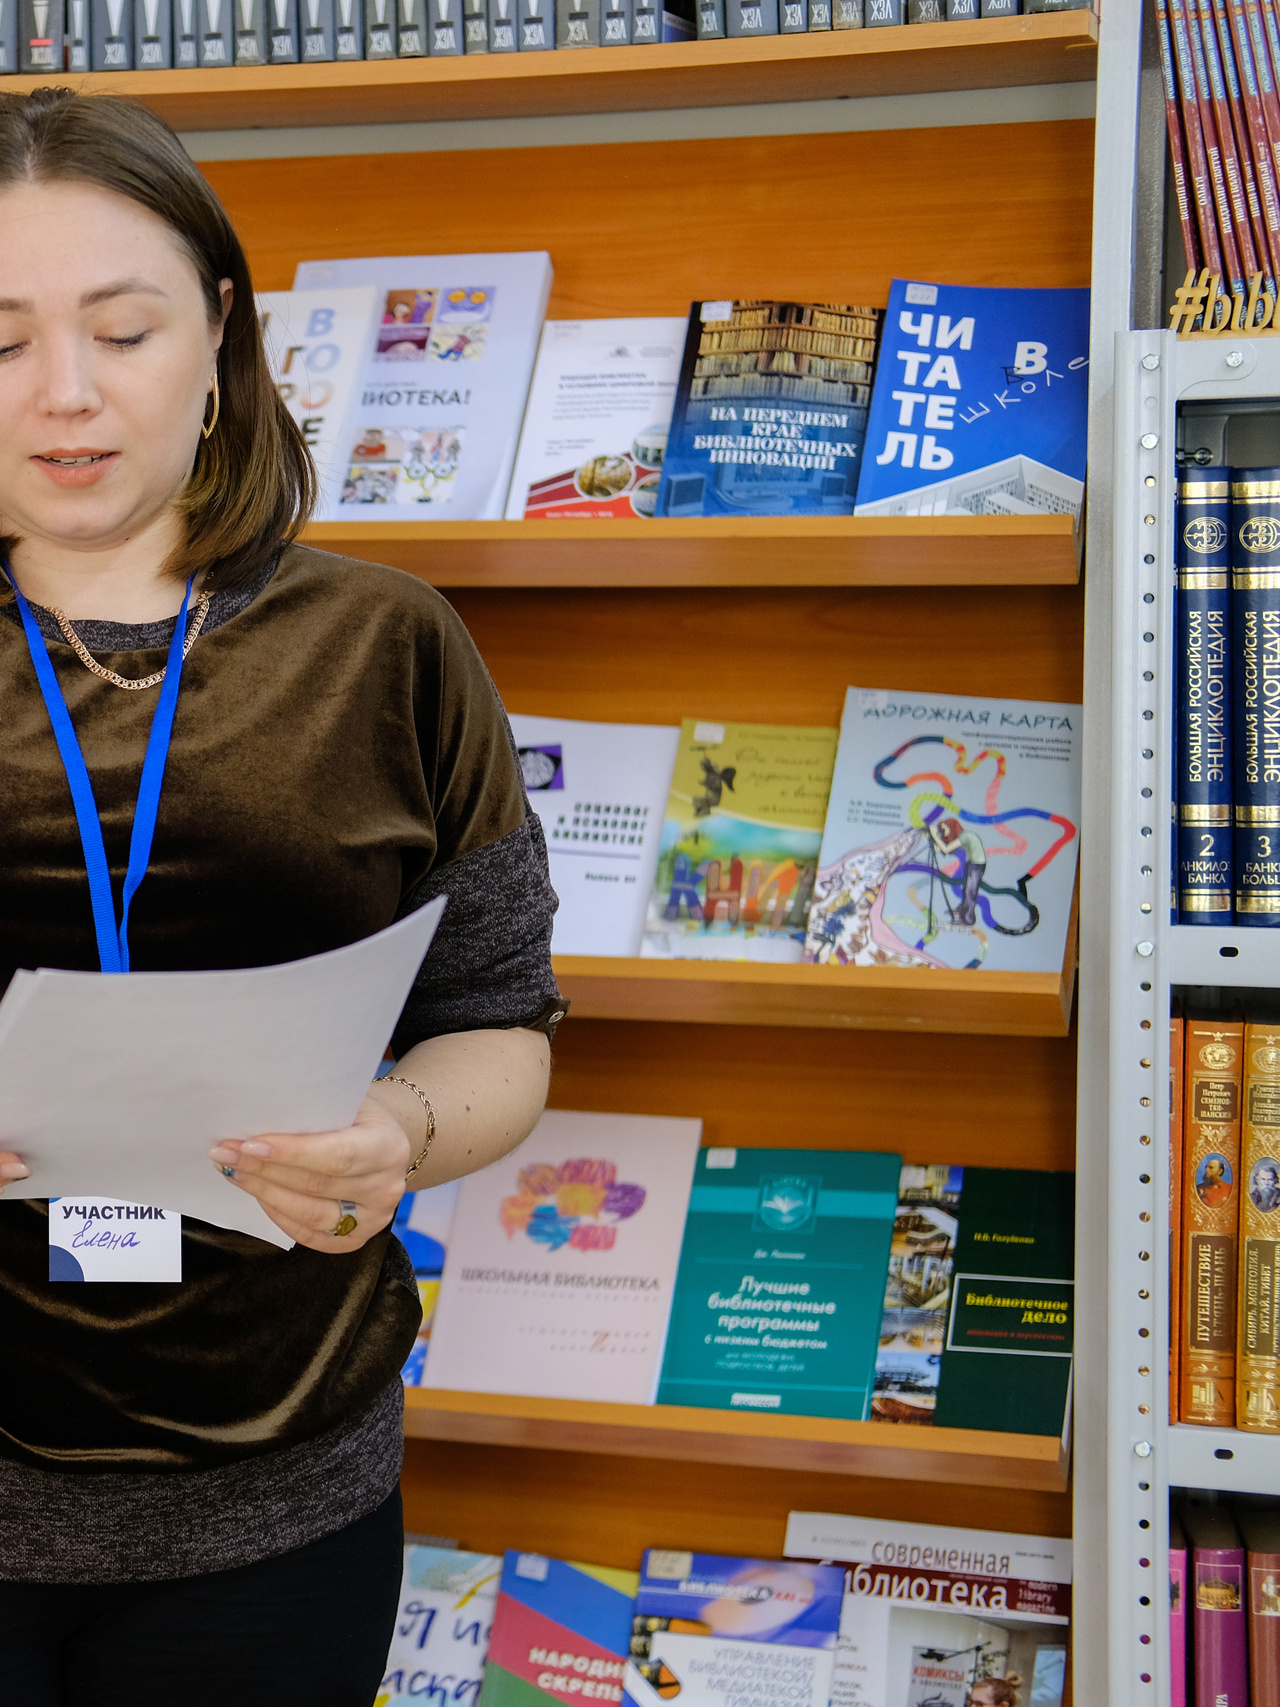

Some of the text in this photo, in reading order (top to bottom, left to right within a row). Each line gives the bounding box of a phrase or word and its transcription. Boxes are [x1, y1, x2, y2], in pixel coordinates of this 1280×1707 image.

[700, 10, 718, 31] ЖЗЛ
[740, 8, 763, 29] ЖЗЛ
[784, 6, 803, 27] ЖЗЛ
[811, 4, 830, 24] ЖЗЛ
[871, 0, 893, 21] ЖЗЛ
[523, 25, 545, 46] ЖЗЛ
[568, 21, 588, 42] ЖЗЛ
[605, 19, 627, 40] ЖЗЛ
[635, 15, 656, 37] ЖЗЛ
[434, 28, 456, 49] ЖЗЛ
[1225, 158, 1240, 193] КАЛИТА
[1259, 162, 1275, 205] ГРОЗНЫЙ
[1174, 162, 1189, 220] ВЕЩИЙ ОЛЕГ
[1195, 175, 1208, 207] ОЛЬГА
[1208, 147, 1232, 233] ВЛАДИМИР СВЯТОЙ
[1233, 199, 1245, 222] ИВАН
[1248, 194, 1261, 217] ИВАН
[710, 406, 850, 429] НА ПЕРЕДНЕМ
[751, 422, 803, 439] КРАЕ
[693, 435, 858, 459] БИБЛИОТЕЧНЫХ
[709, 450, 837, 471] ИННОВАЦИЙ
[1187, 611, 1202, 782] БОЛЬШАЯ РОССИЙСКАЯ
[1207, 611, 1227, 782] ЭНЦИКЛОПЕДИЯ
[1243, 611, 1259, 783] БОЛЬШАЯ РОССИЙСКАЯ
[1262, 611, 1280, 783] ЭНЦИКЛОПЕДИЯ
[864, 703, 1073, 732] ДОРОЖНАЯ КАРТА
[1199, 834, 1215, 857] 2
[1257, 835, 1272, 858] 3
[1188, 873, 1227, 884] БАНКА
[62, 1206, 166, 1220] УЧАСТНИК
[72, 1220, 141, 1250] Елена
[461, 1268, 661, 1292] ШКОЛЬНАЯ БИБЛИОТЕКА
[739, 1275, 811, 1297] Лучшие
[1213, 1247, 1226, 1328] ТЯНЬ-ШАНЬ
[708, 1292, 837, 1315] библиотечные
[966, 1292, 1069, 1311] Библиотечное
[1197, 1244, 1212, 1342] ПУТЕШЕСТВИЕ
[1247, 1248, 1259, 1349] СИБИРЬ. МОНГОЛИЯ.
[1259, 1264, 1272, 1334] КИТАЙ. ТИБЕТ
[718, 1315, 820, 1334] программы
[1021, 1310, 1068, 1325] дело
[871, 1540, 1010, 1575] современная
[713, 1648, 817, 1666] УПРАВЛЕНИЕ
[913, 1666, 965, 1682] КОМИКСЫ
[707, 1677, 813, 1699] МЕДИАТЕКОЙ
